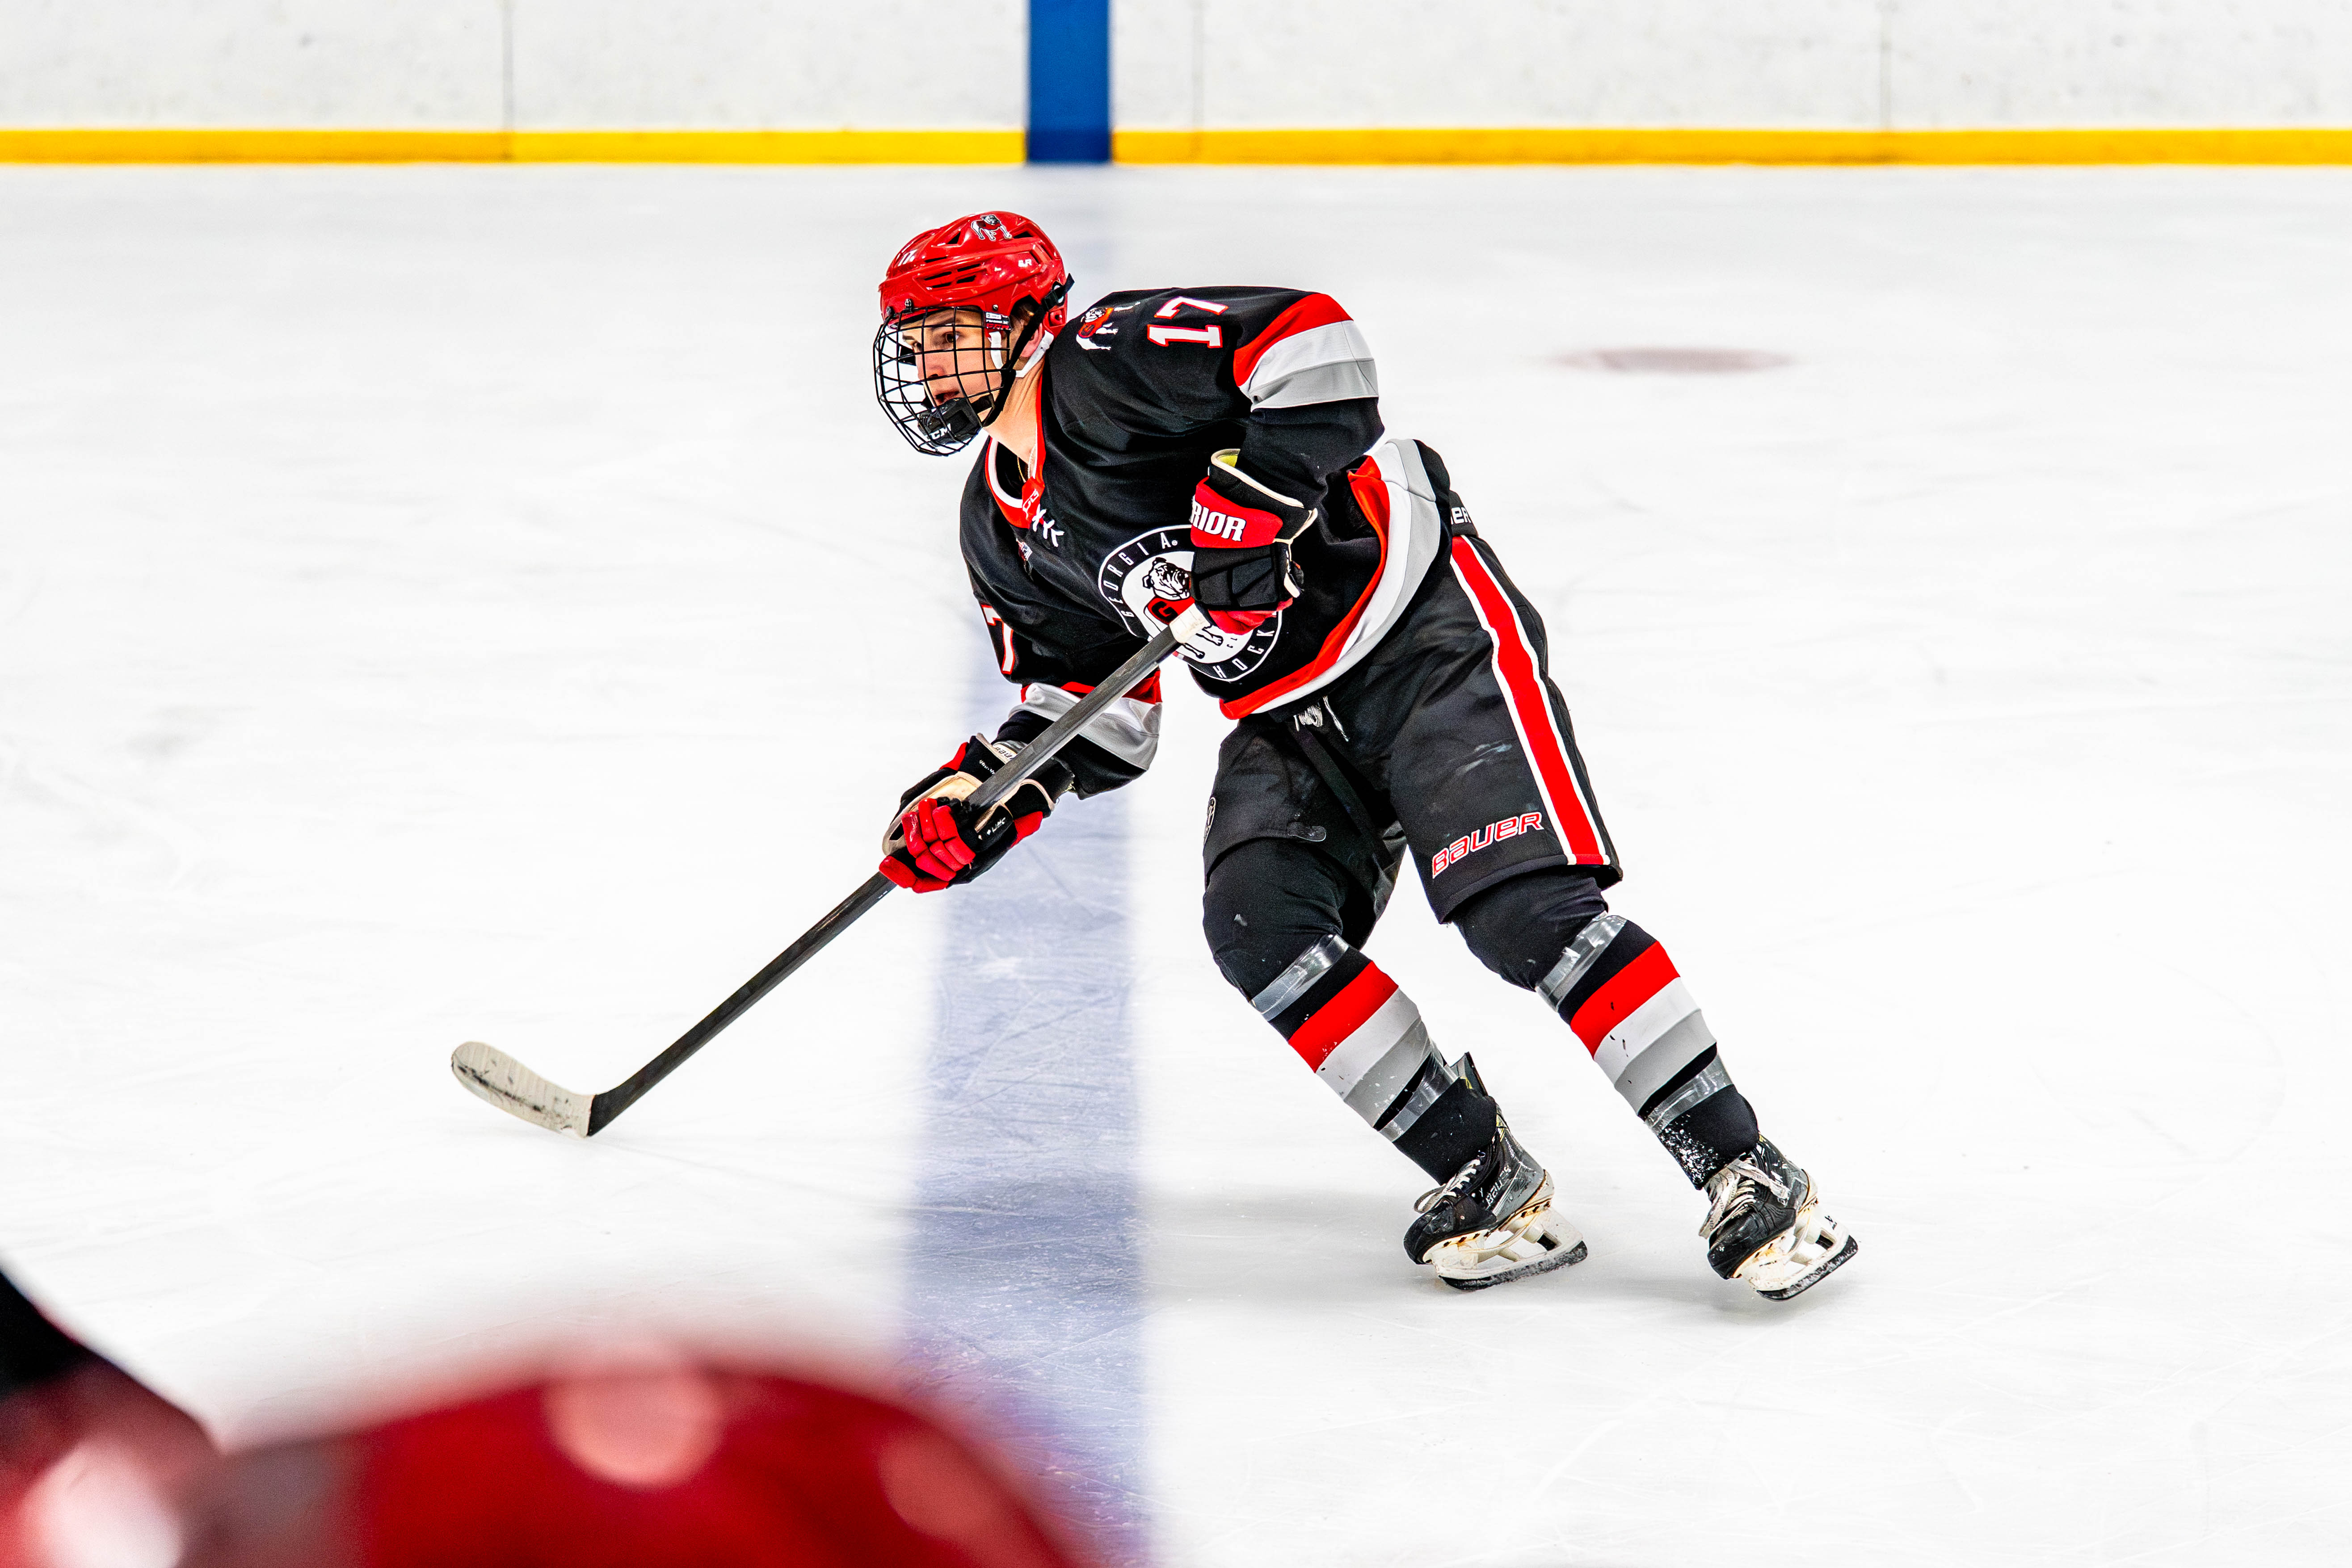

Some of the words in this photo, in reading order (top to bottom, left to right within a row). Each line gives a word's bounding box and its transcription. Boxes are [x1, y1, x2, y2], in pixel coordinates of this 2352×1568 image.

[1147, 296, 1229, 349] 17
[1103, 532, 1171, 617] GEORGIA
[1213, 610, 1277, 678] HOCK
[1432, 811, 1544, 879] BAUER
